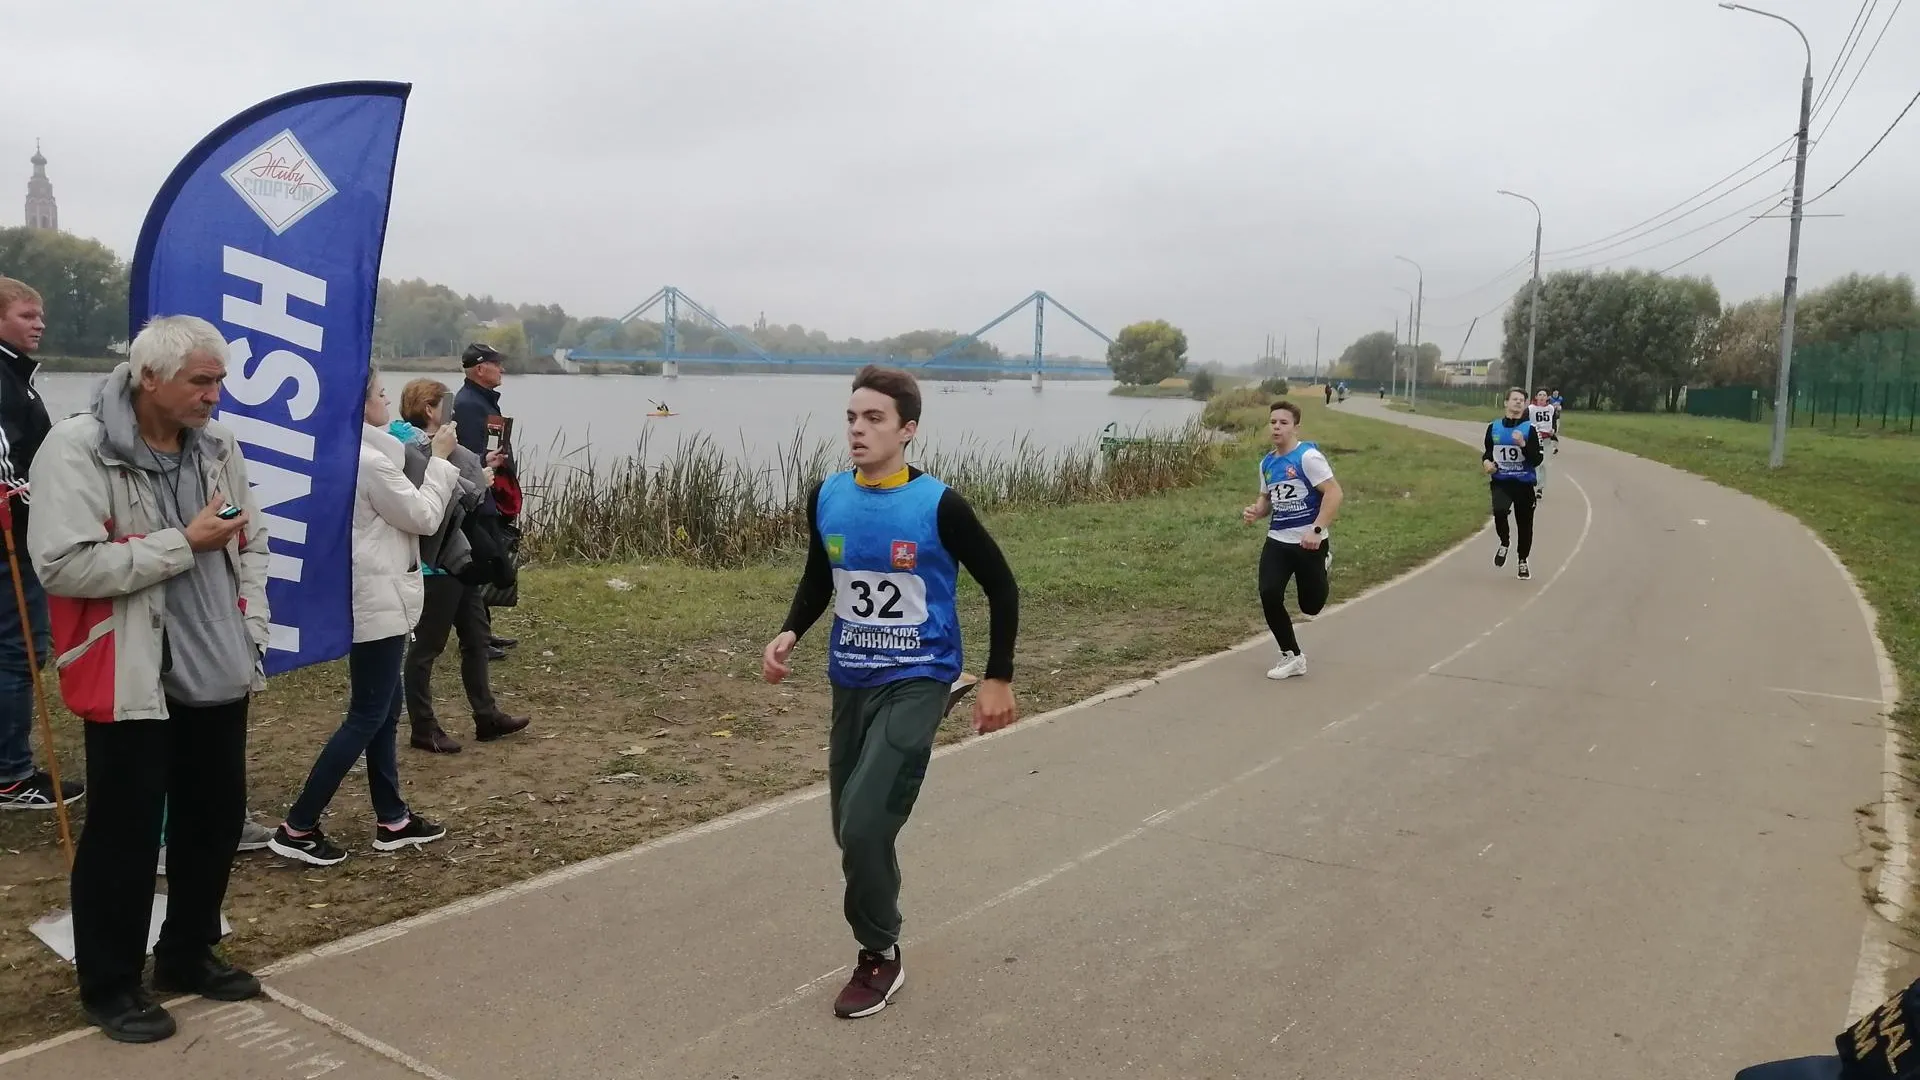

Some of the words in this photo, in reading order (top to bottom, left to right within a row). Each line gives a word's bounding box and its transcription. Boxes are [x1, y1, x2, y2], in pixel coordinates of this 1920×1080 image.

[1535, 410, 1551, 423] 65
[1499, 447, 1519, 461] 19
[1274, 483, 1298, 501] 12
[850, 579, 904, 619] 32
[839, 629, 921, 651] БРОННИЦЫ
[892, 627, 919, 638] КЛУБ
